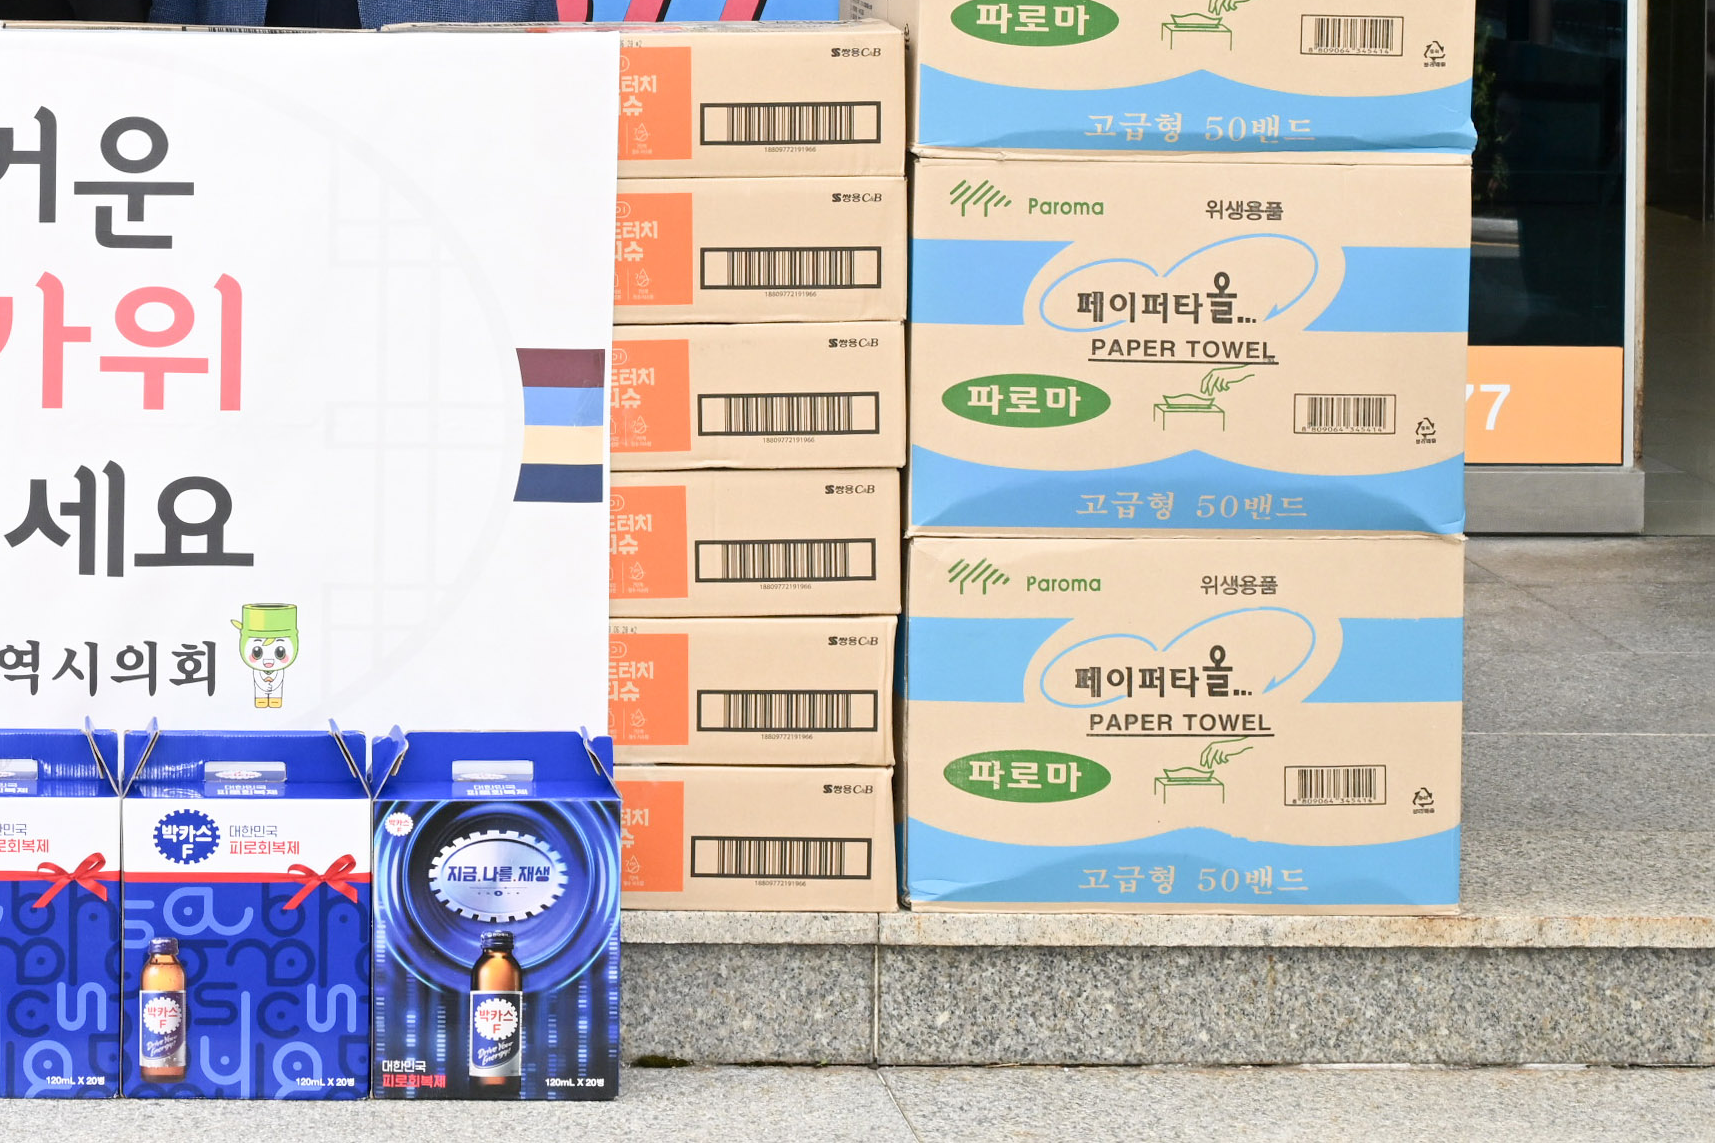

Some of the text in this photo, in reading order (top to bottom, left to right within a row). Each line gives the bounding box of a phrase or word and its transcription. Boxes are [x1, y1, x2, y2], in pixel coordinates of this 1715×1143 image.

[975, 3, 1090, 36] 파로마
[1084, 111, 1316, 144] 고급형 50밴드
[1028, 197, 1104, 216] Paroma
[1205, 199, 1284, 221] 위생용품
[1090, 338, 1276, 360] PAPER TOWEL
[967, 384, 1081, 417] 파로마
[1075, 492, 1308, 521] 고급형 50밴드
[1026, 574, 1102, 593] Paroma
[1200, 574, 1279, 596] 위생용품
[1089, 712, 1273, 733] PAPER TOWEL
[969, 759, 1082, 792] 파로마
[162, 825, 212, 843] 박카스
[229, 825, 278, 837] 대한민국
[182, 844, 193, 858] F
[230, 840, 300, 855] 피로회복제
[447, 865, 550, 882] 지금.나를.재생
[1078, 867, 1309, 894] 고급형 50밴드
[147, 1007, 179, 1018] 박카스
[479, 1010, 514, 1022] 박카스
[382, 1060, 426, 1073] 대한민국
[46, 1076, 105, 1086] 120mL 20병
[296, 1077, 355, 1087] 120mL 20병
[382, 1074, 446, 1088] 피로회복제
